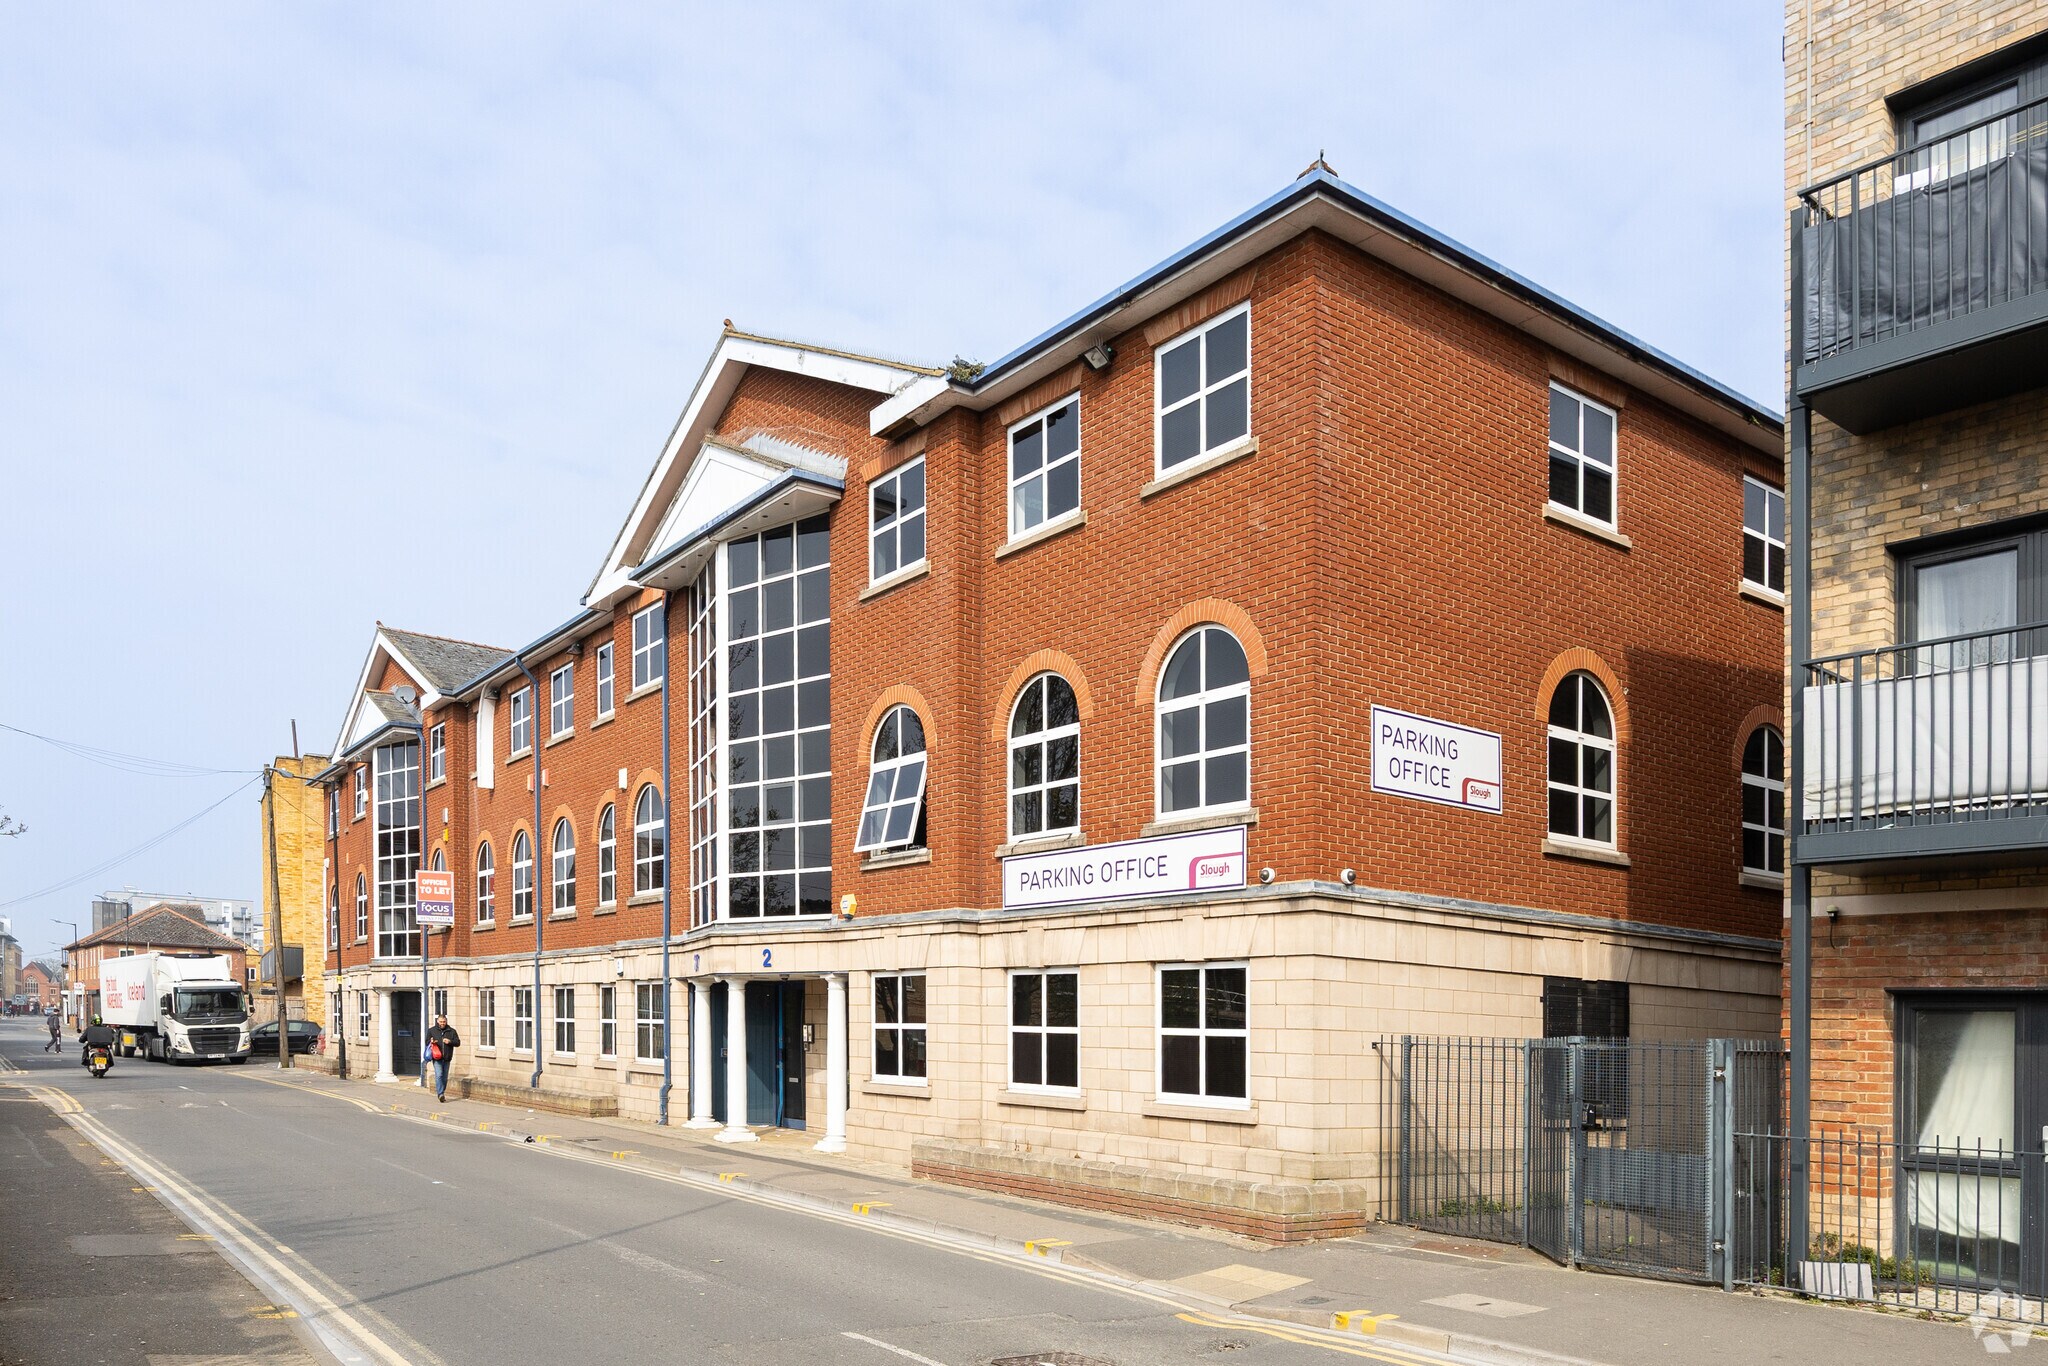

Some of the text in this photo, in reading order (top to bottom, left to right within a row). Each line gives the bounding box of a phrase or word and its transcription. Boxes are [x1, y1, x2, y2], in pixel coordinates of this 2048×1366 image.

[1382, 724, 1458, 760] PARKING
[1389, 757, 1450, 789] OFFICE
[1470, 785, 1491, 799] Slough
[1020, 855, 1168, 891] PARKING OFFICE
[1200, 862, 1230, 876] Slough
[419, 886, 451, 895] TO LET
[762, 948, 772, 968] 2
[391, 973, 397, 985] 2
[127, 981, 146, 1000] Iceland
